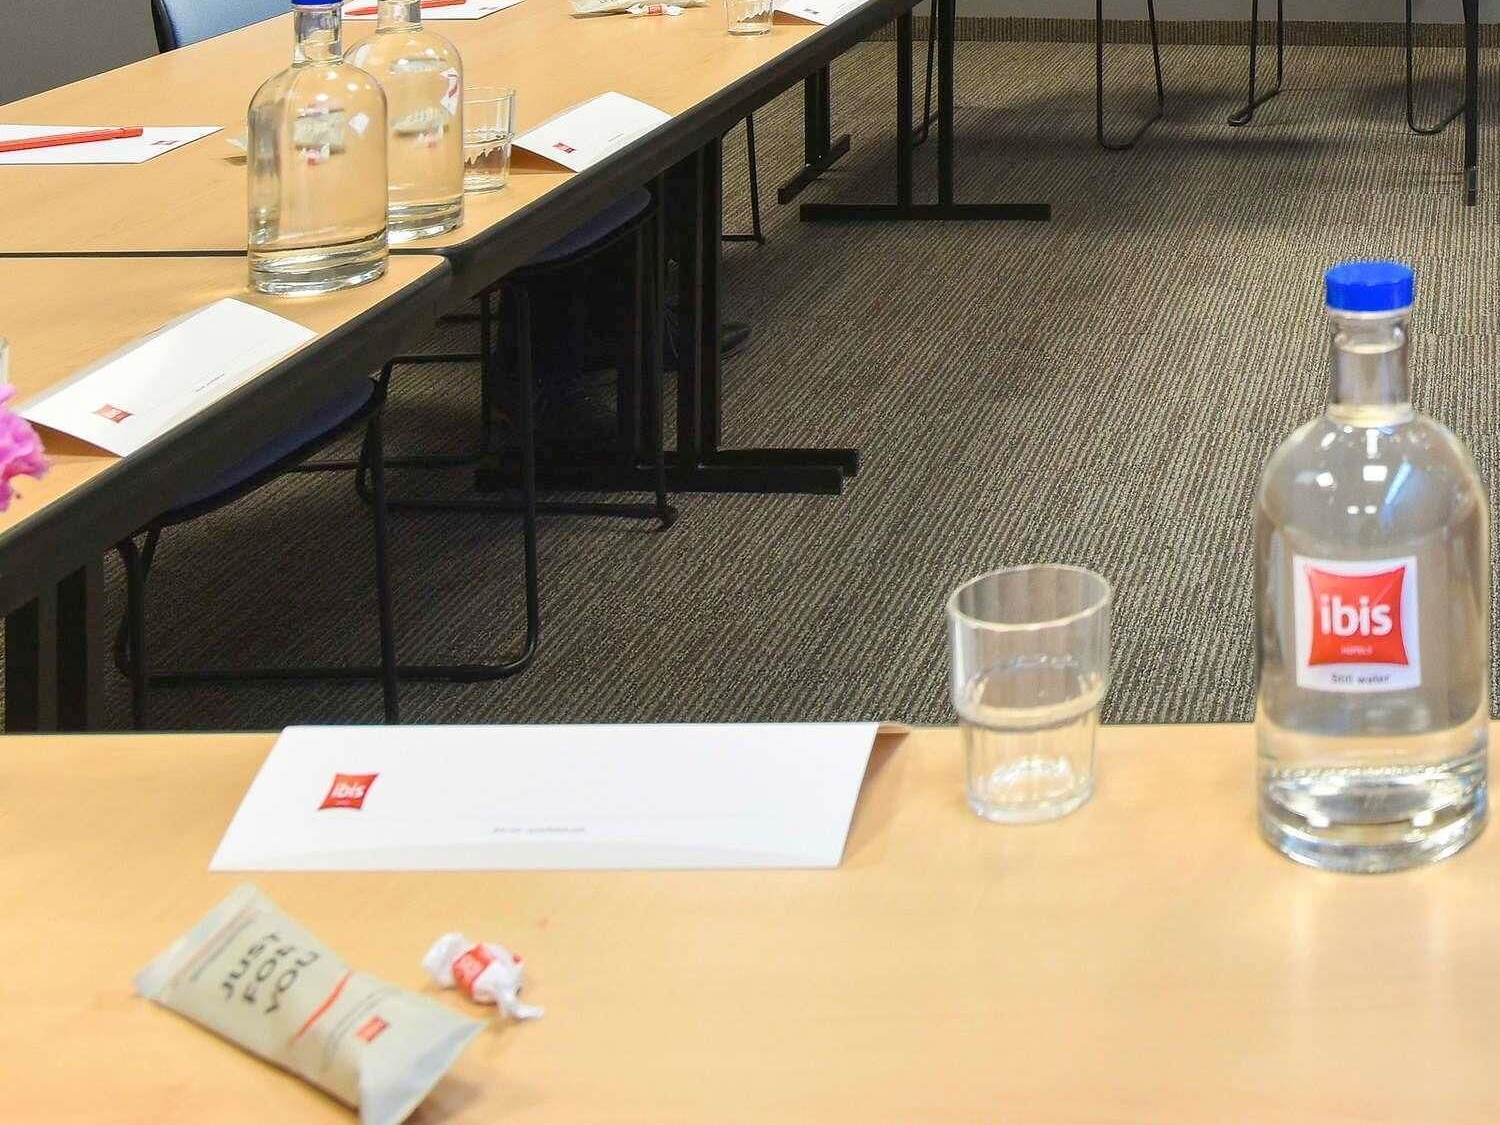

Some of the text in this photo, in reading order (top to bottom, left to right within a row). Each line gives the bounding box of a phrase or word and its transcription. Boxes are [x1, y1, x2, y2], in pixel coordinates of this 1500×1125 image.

[1320, 594, 1393, 637] ibis
[221, 933, 279, 1002] JUST
[242, 946, 299, 1005] FOR
[265, 950, 320, 1014] YOU
